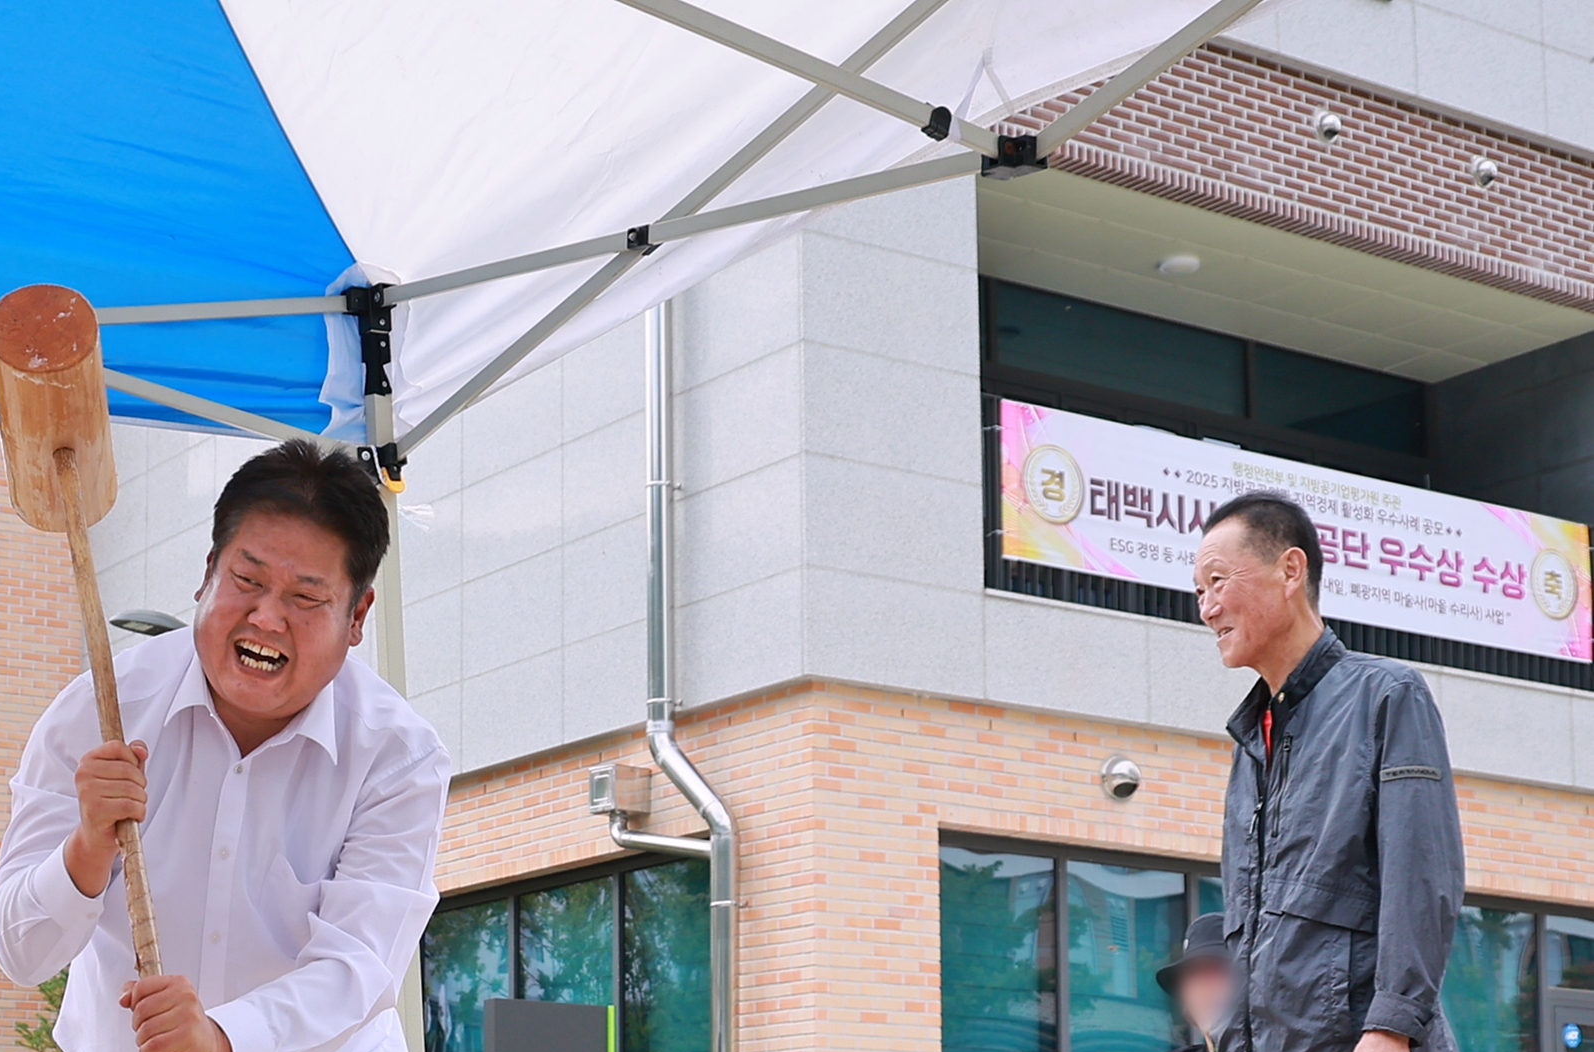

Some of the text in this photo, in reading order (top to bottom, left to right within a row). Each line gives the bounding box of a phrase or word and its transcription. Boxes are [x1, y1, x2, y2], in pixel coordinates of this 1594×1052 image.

[1041, 467, 1066, 502] 경
[1186, 469, 1218, 488] 2025
[1341, 501, 1374, 523] 활성화
[1378, 509, 1420, 532] 우수사례
[1423, 518, 1444, 537] 공모
[1232, 461, 1285, 485] 행정안전부
[1287, 469, 1298, 488] 및
[1300, 476, 1380, 506] 지방공기업평가원
[1110, 537, 1134, 555] ESG
[1137, 541, 1161, 561] 경영
[1164, 547, 1174, 563] 등
[1350, 583, 1391, 605] 폐광지역
[1450, 601, 1483, 621] 수리사)
[1380, 536, 1464, 588] 우수상
[1473, 557, 1528, 600] 수상
[1544, 570, 1563, 600] 축
